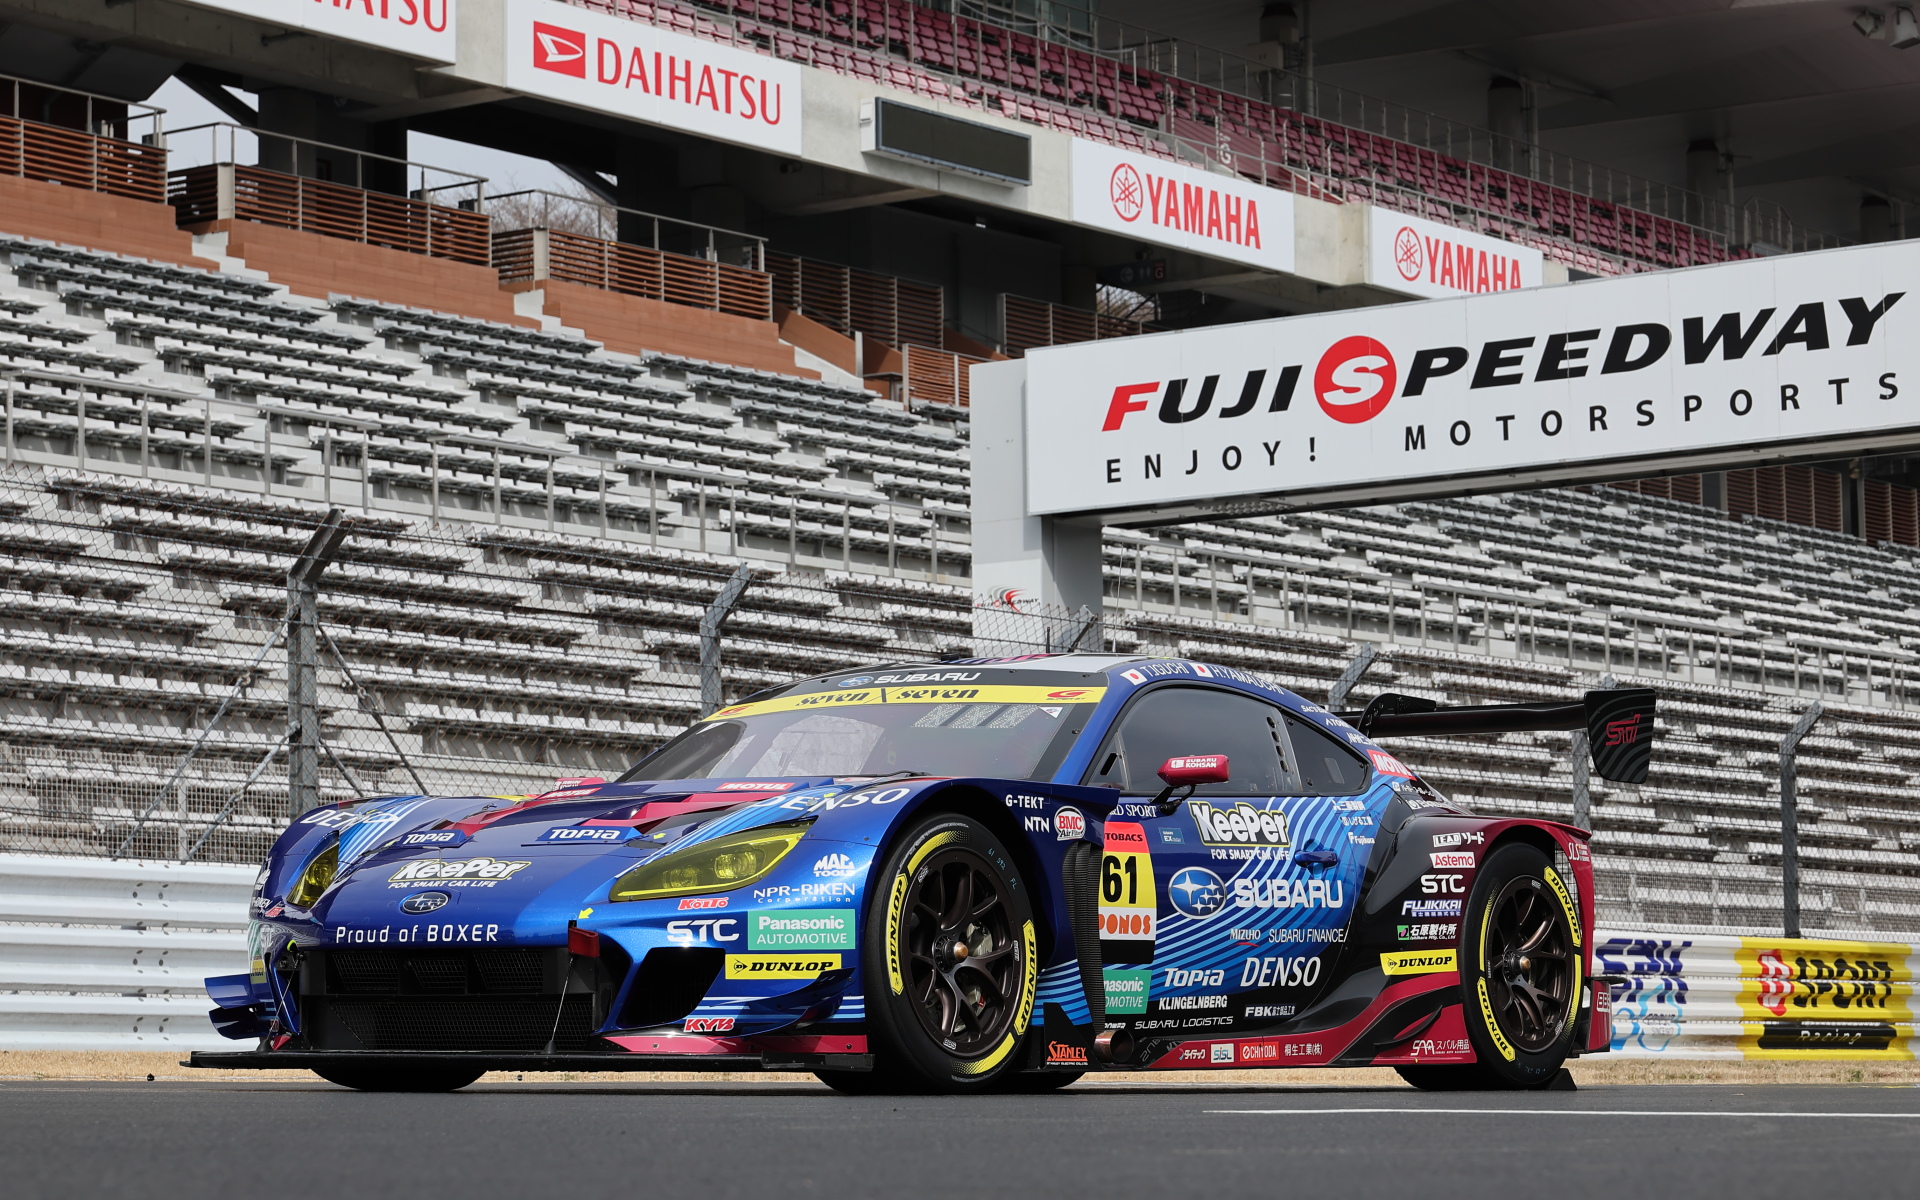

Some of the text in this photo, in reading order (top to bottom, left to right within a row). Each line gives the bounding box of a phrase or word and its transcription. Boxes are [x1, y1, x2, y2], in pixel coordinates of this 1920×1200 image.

[597, 38, 781, 126] DAIHATSU
[1146, 173, 1262, 250] YAMAHA
[1425, 235, 1522, 294] YAMAHA
[1102, 292, 1907, 432] FUJI SPEEDWAY
[1106, 372, 1899, 484] ENJOY! MOTORSPORTS
[874, 672, 981, 684] SUBARU
[796, 690, 869, 706] seven
[896, 688, 979, 699] seven
[720, 782, 790, 791] MOTUL
[751, 788, 910, 812] DENSO
[1006, 794, 1045, 809] G-TEKT
[1125, 804, 1157, 817] SPORT
[1025, 816, 1050, 833] NTN
[1058, 816, 1082, 830] BMC
[1191, 804, 1288, 843] KeePer
[1105, 832, 1143, 842] TOBACS
[813, 853, 856, 870] MAC
[1211, 849, 1291, 860] FOR SMART CAR LIFE
[1435, 854, 1474, 867] Astemo
[392, 859, 527, 880] KeePer
[388, 880, 498, 889] FOR SMART CAR LIFE
[1102, 855, 1137, 905] 61
[1421, 875, 1466, 893] STC
[753, 883, 856, 898] NPR-RIKEN
[1234, 878, 1344, 909] SUBARU
[1401, 899, 1462, 916] FUJIKIKAI
[1550, 876, 1581, 940] DUNLOP
[666, 919, 740, 942] STC
[758, 916, 845, 930] Panasonic
[888, 878, 904, 976] DUNLOP
[1410, 923, 1457, 936] 石原製作所
[335, 923, 499, 944] Proud of BOXER
[757, 933, 847, 944] AUTOMOTIVE
[1230, 928, 1344, 943] MIZUHO SUBARU FINANCE
[749, 961, 834, 972] DUNLOP
[1398, 956, 1453, 968] DUNLOP
[1240, 956, 1321, 987] DENSO
[1021, 938, 1036, 1031] DUNLOP
[1104, 977, 1144, 992] nasonic
[1159, 995, 1228, 1011] KLINGELNBERG
[1245, 1006, 1273, 1017] FBK
[684, 1017, 736, 1033] KYB
[1135, 1016, 1234, 1030] SUBARU LOGISTICS
[1478, 982, 1508, 1054] DUNLOP
[1797, 1028, 1862, 1045] Racing
[1047, 1041, 1089, 1061] STANLEY
[1250, 1045, 1277, 1059] CHIYODA
